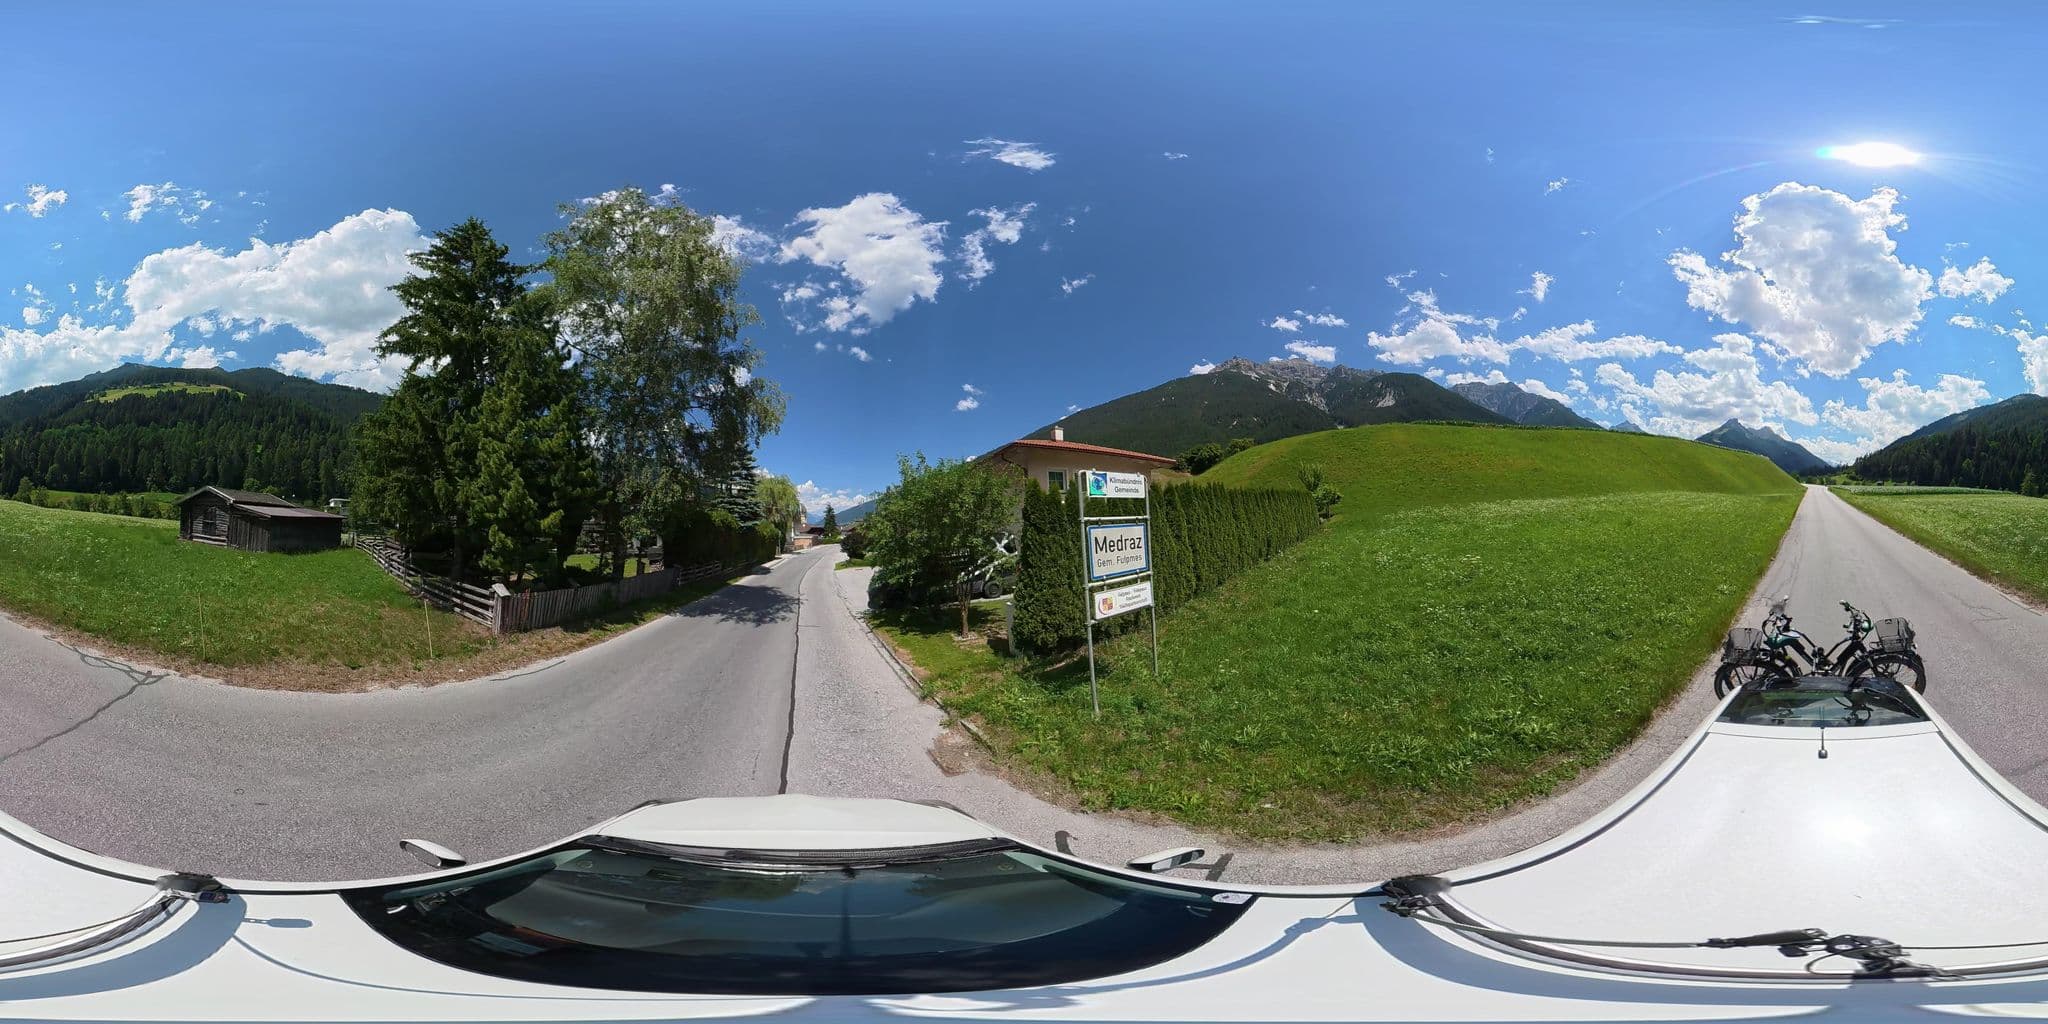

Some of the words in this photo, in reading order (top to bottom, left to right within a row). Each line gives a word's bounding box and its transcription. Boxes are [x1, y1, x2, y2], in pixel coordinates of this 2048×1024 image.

[1094, 534, 1142, 554] Medraz
[1097, 558, 1115, 567] Gem.
[1116, 555, 1142, 565] Fulpmes
